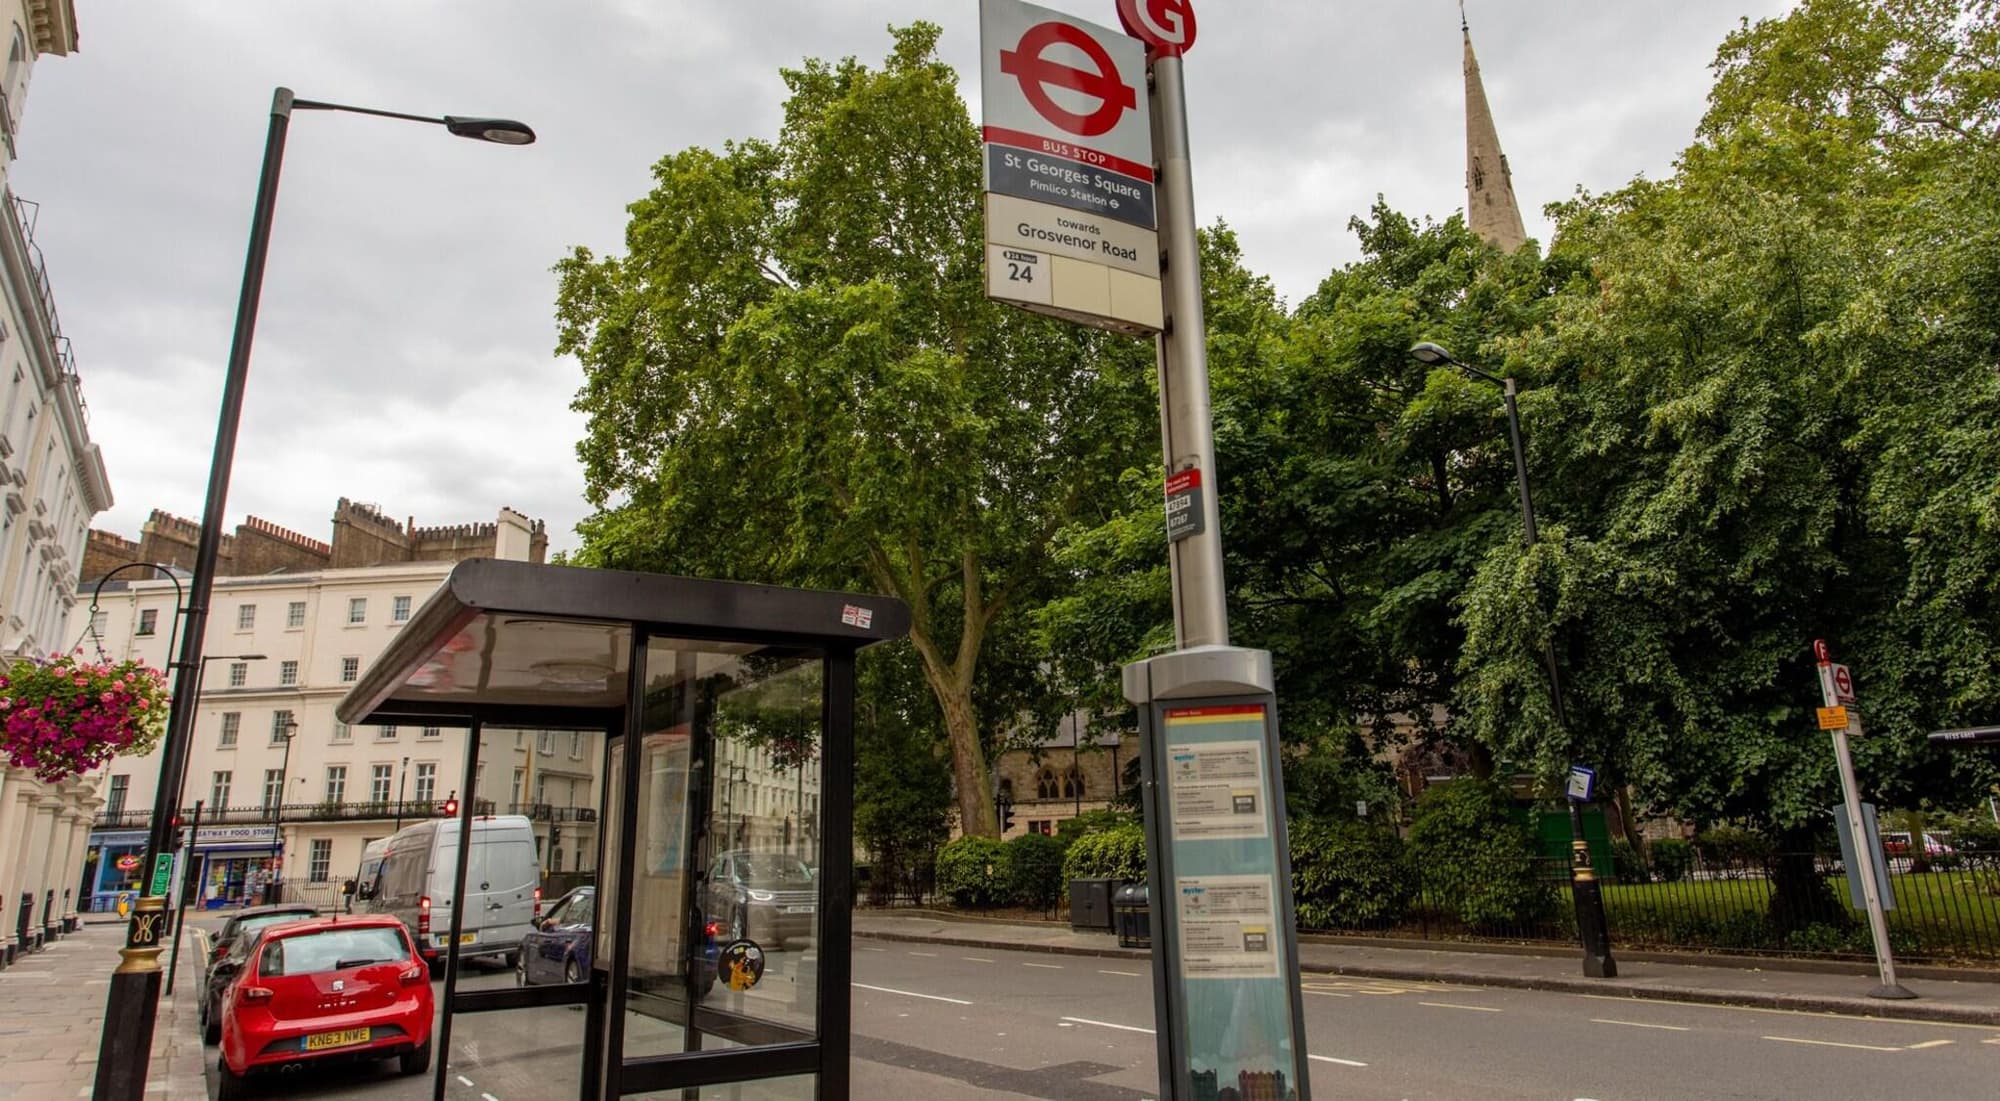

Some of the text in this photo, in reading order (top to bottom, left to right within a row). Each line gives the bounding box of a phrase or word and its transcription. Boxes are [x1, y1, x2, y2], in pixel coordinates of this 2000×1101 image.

[1135, 0, 1186, 44] G
[1043, 140, 1106, 165] BUS STOP
[1004, 153, 1141, 200] St Georges Square
[1030, 179, 1108, 207] Pimlico Station
[1057, 217, 1101, 235] towards
[1017, 222, 1137, 261] Grosvenor Road
[1008, 263, 1033, 283] 24
[230, 829, 250, 837] FOOD
[309, 1034, 341, 1047] KN63
